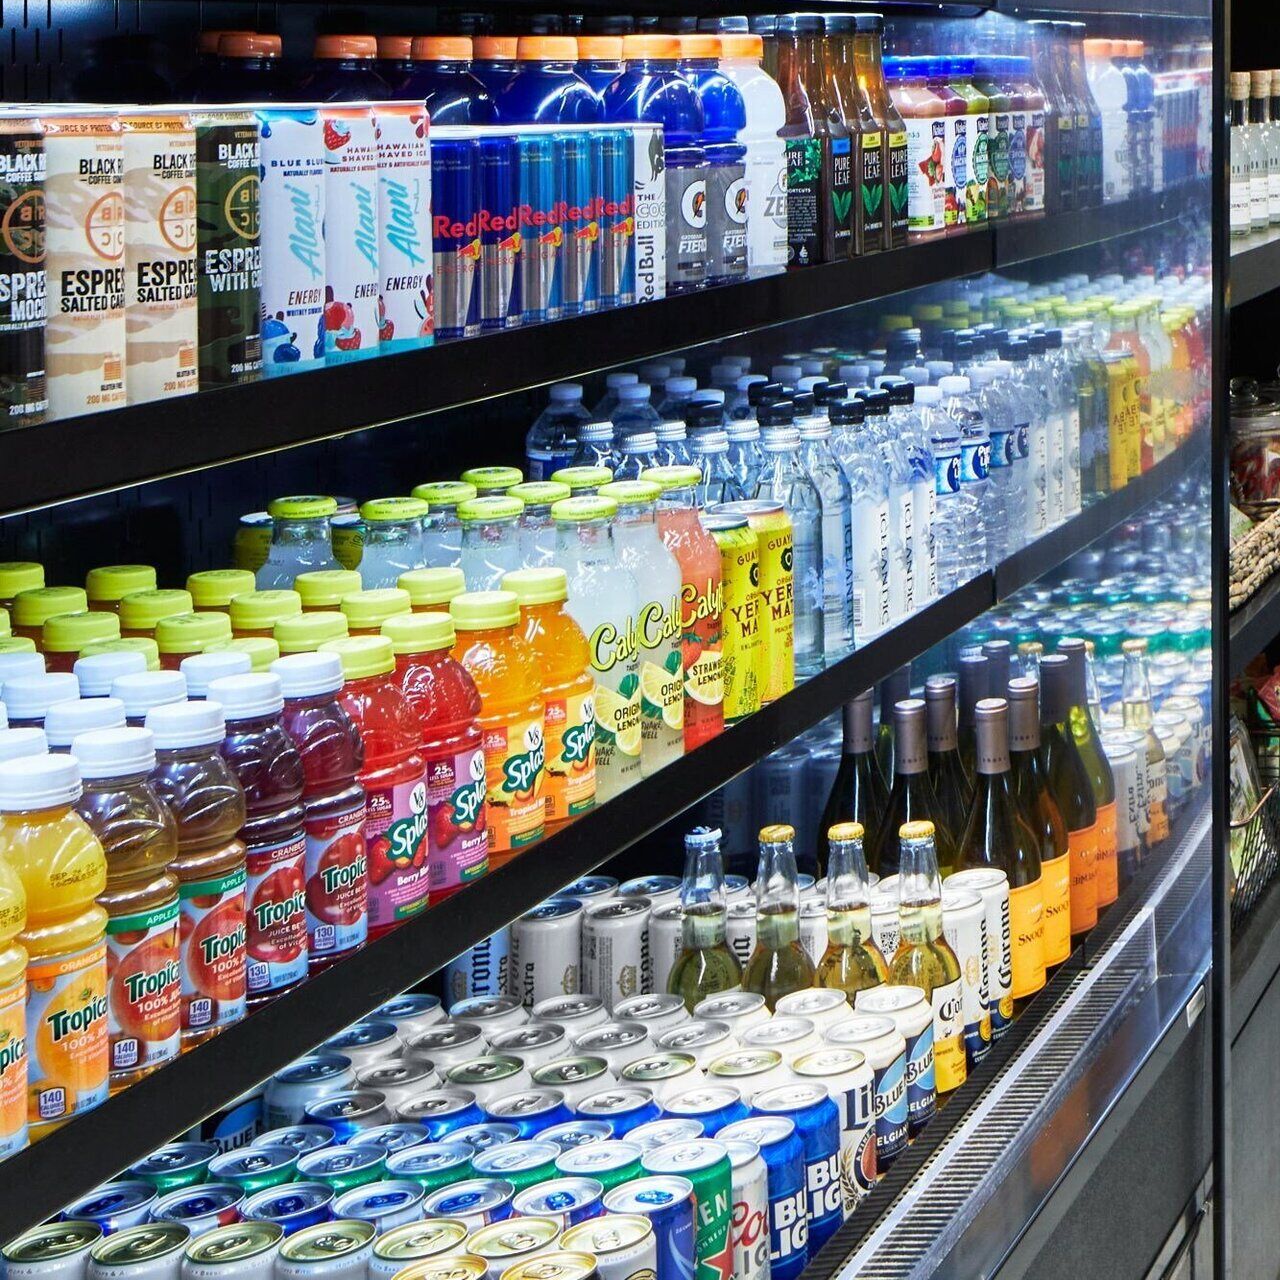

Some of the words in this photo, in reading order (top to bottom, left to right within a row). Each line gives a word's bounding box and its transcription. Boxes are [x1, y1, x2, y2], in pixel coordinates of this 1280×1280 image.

[218, 143, 255, 160] BLACK
[377, 143, 425, 151] HAWAIIAN
[153, 154, 188, 170] BLACK
[228, 160, 249, 169] COFFEE
[271, 159, 302, 168] BLUE
[834, 157, 850, 172] PURE
[864, 151, 881, 166] PURE
[890, 149, 908, 164] PURE
[80, 158, 116, 175] BLACK
[864, 164, 881, 179] LEAF
[891, 163, 908, 179] LEAF
[6, 172, 34, 183] COFFEE
[88, 175, 111, 185] COFFEE
[162, 170, 184, 180] COFFEE
[834, 172, 850, 187] LEAF
[597, 194, 631, 216] Red
[638, 193, 656, 201] THE
[519, 204, 558, 227] Red
[559, 200, 594, 221] Red
[380, 177, 425, 269] Alani
[433, 213, 480, 239] Red
[479, 207, 519, 232] Red
[284, 183, 323, 282] Alani
[350, 182, 380, 274] Alani
[638, 235, 655, 270] Bull
[210, 272, 250, 292] WITH
[385, 275, 424, 291] ENERGY
[638, 272, 655, 303] Red
[137, 286, 181, 303] SALTED
[288, 288, 322, 306] ENERGY
[61, 297, 107, 313] SALTED
[231, 363, 244, 373] 200
[164, 382, 176, 392] 200
[86, 394, 101, 405] 200
[9, 404, 24, 415] 200
[905, 502, 914, 612] ICELANDIC
[880, 512, 890, 626] ICELANDIC
[528, 729, 540, 744] V8
[434, 765, 453, 776] 25%
[473, 757, 484, 774] V8
[371, 796, 391, 808] 25%
[414, 787, 426, 804] V8
[509, 800, 538, 818] Tropical
[461, 836, 481, 851] Berry
[221, 875, 242, 891] APPLE
[397, 872, 419, 887] Berry
[335, 890, 354, 902] JUICE
[147, 910, 170, 926] APPLE
[269, 926, 291, 939] JUICE
[317, 926, 333, 938] 130
[998, 897, 1013, 989] Corona
[60, 955, 95, 973] ORANGE
[212, 959, 239, 975] 100%
[250, 965, 266, 976] 130
[523, 962, 535, 1009] Extra
[138, 997, 169, 1013] 100%
[191, 1000, 210, 1014] 140
[62, 1034, 95, 1051] 100%
[116, 1041, 135, 1054] 140
[906, 1052, 934, 1082] BLUE
[42, 1090, 62, 1104] 140
[875, 1081, 905, 1116] BLUE
